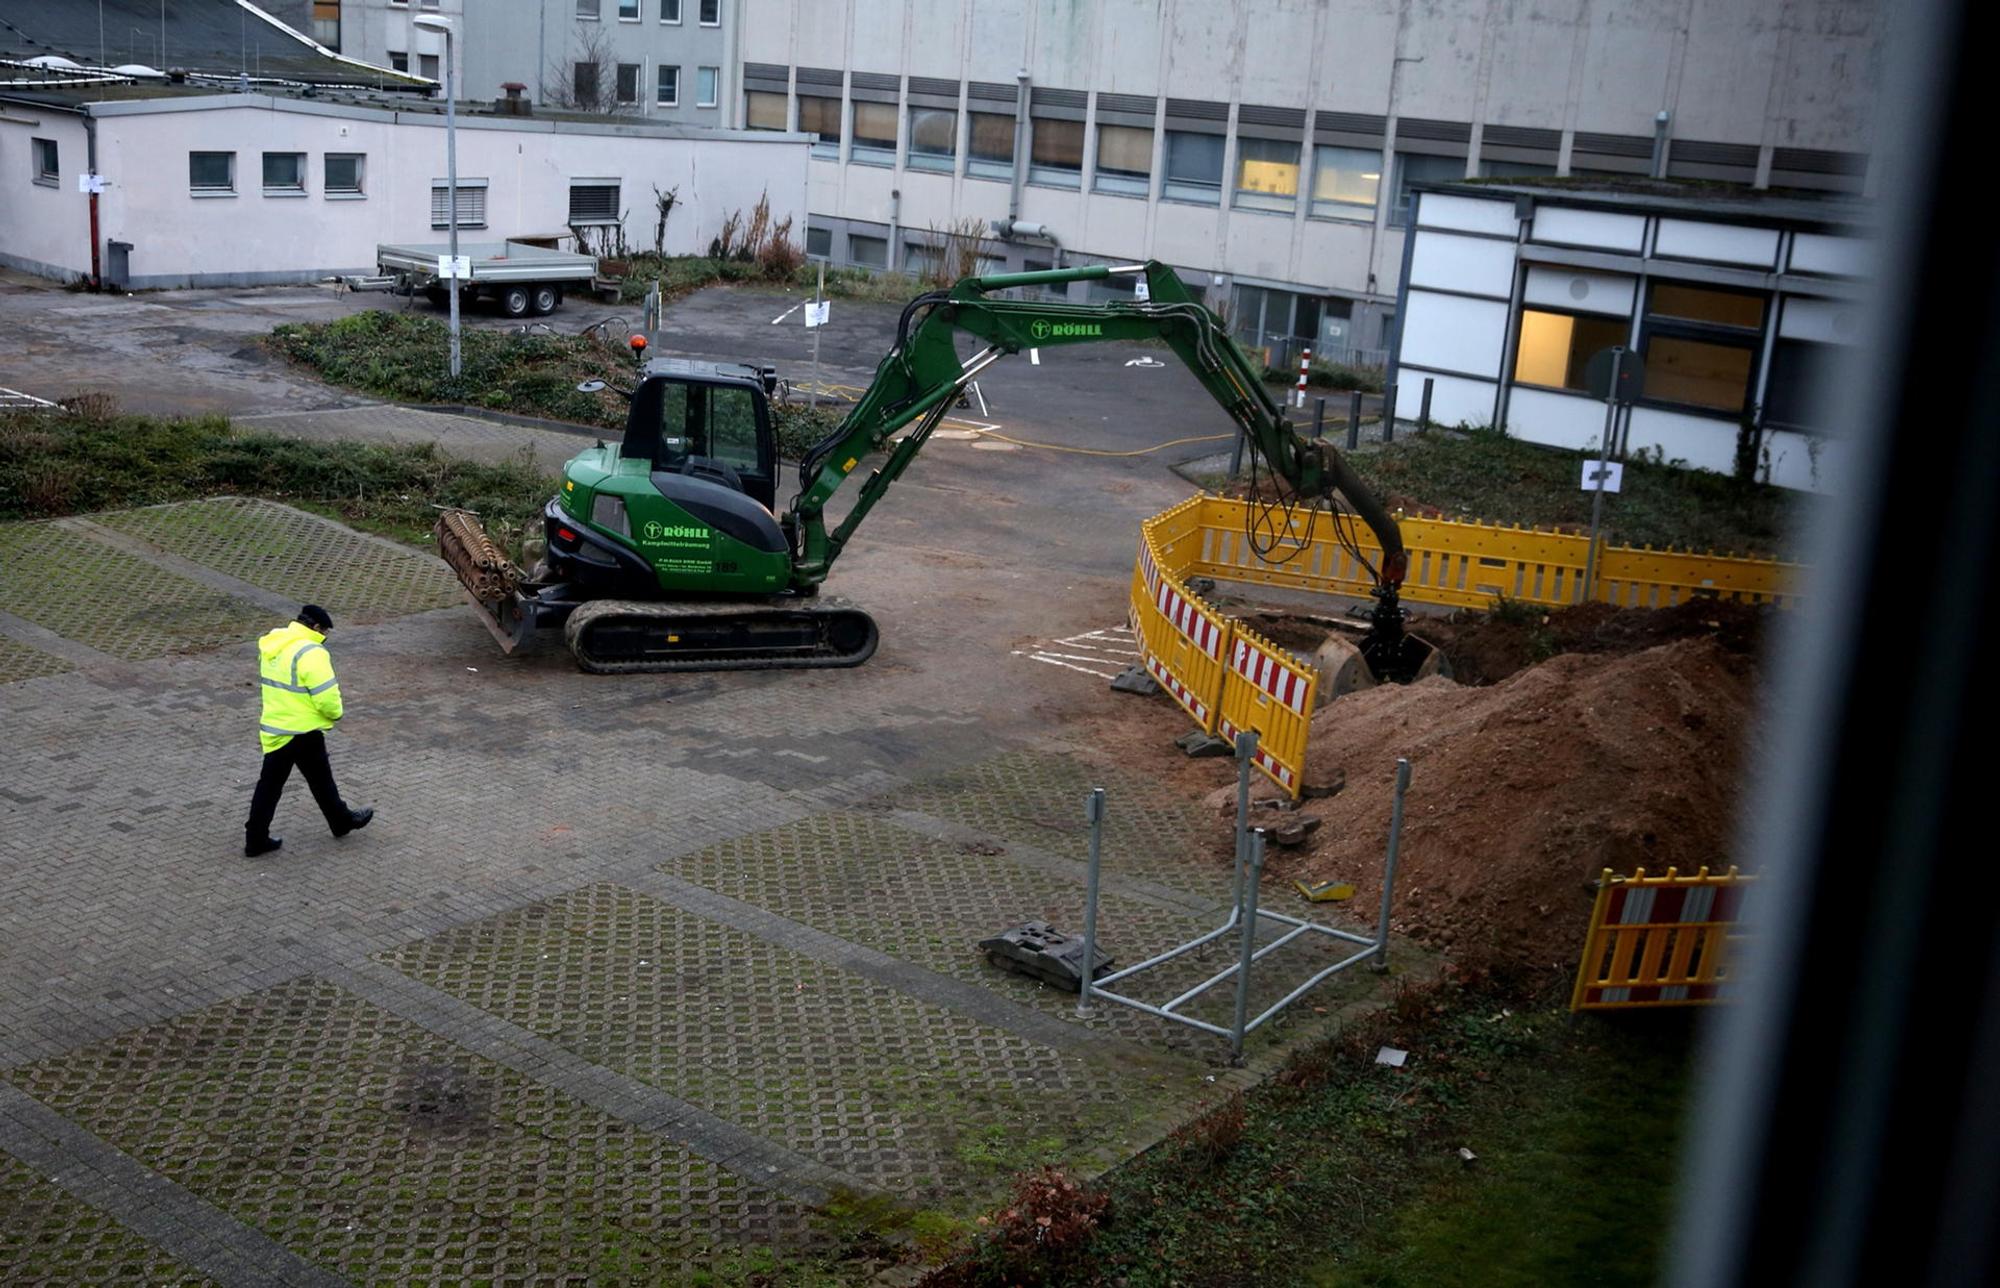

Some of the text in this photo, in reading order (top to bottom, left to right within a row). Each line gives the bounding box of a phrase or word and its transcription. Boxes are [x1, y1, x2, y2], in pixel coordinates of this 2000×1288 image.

[1052, 322, 1103, 336] RÖHLL
[664, 525, 710, 538] RÖHLL
[642, 540, 710, 549] Kampfmittelräumung
